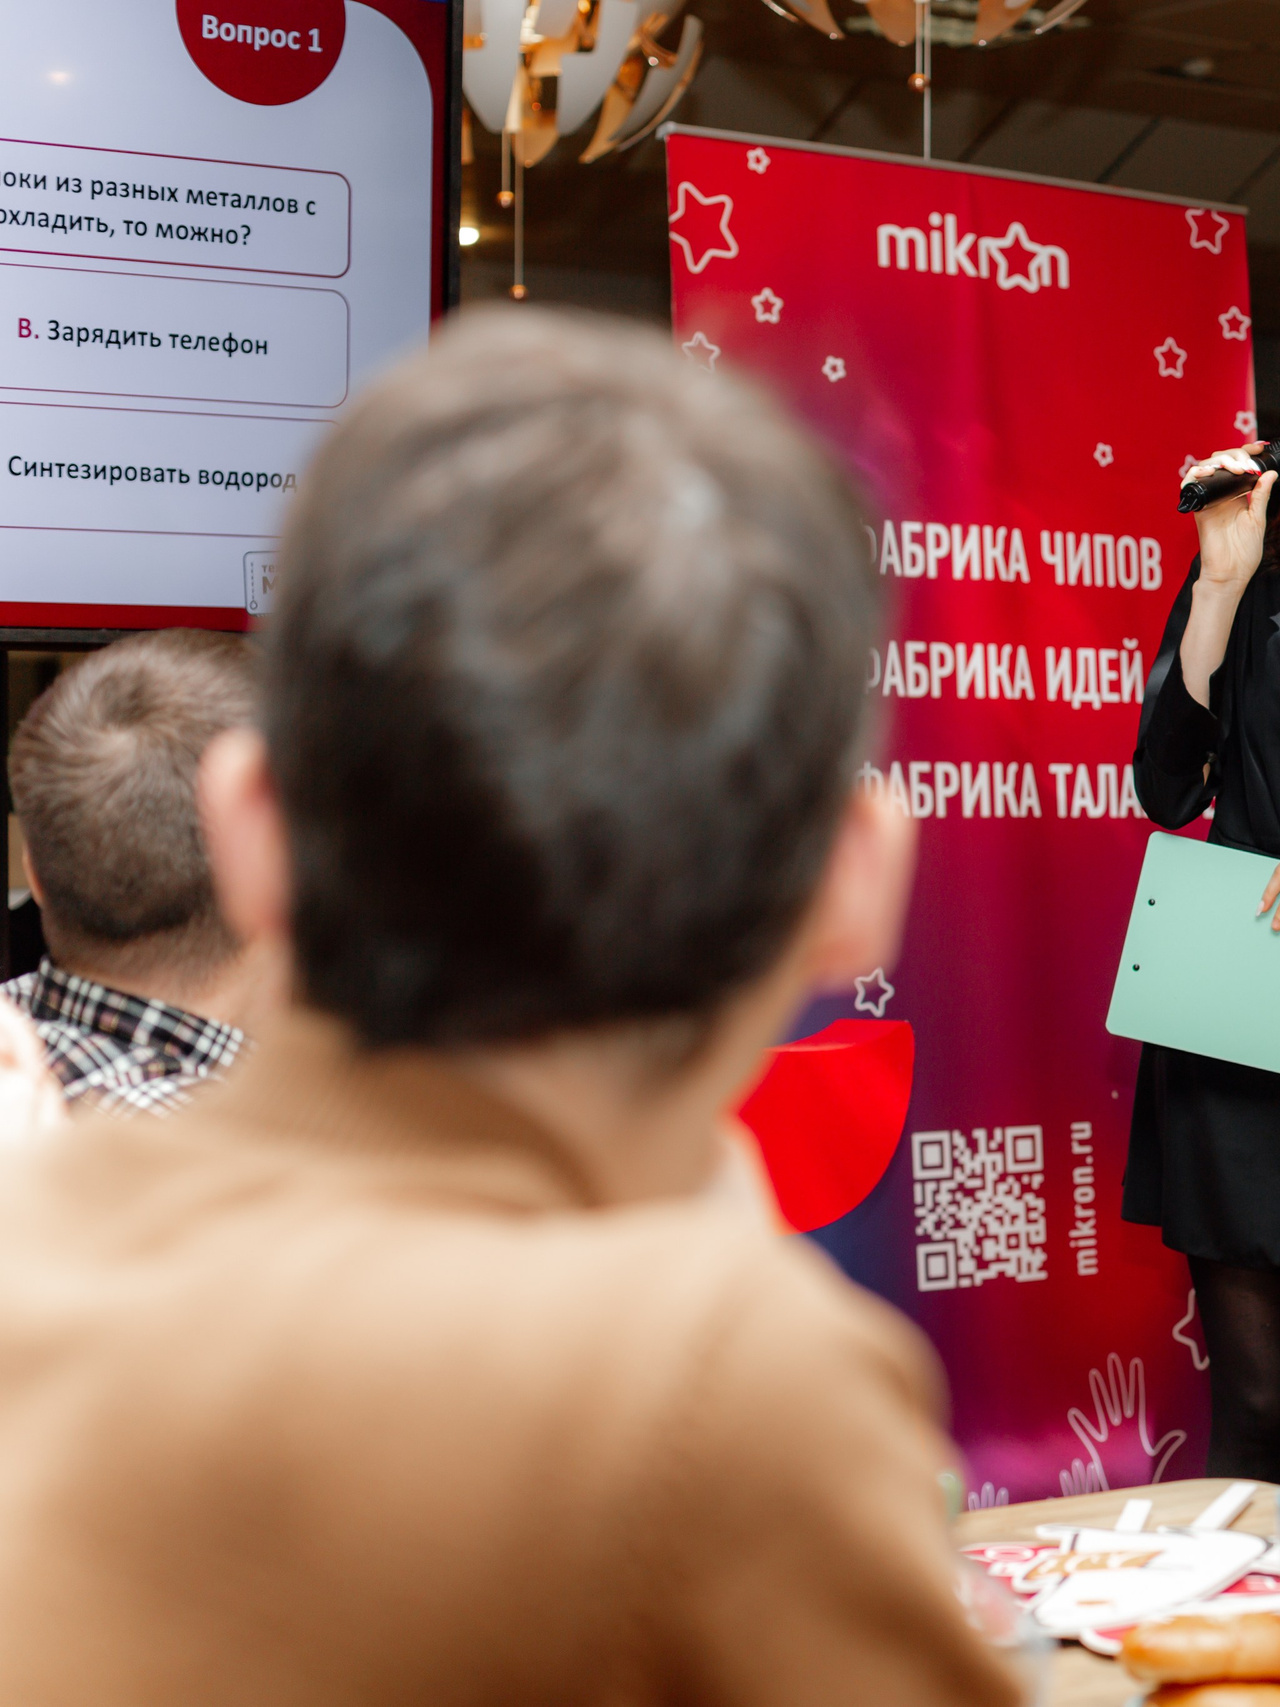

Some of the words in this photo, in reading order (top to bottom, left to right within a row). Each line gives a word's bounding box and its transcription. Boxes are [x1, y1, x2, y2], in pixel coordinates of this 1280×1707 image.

[201, 14, 302, 51] Вопрос
[307, 28, 323, 53] 1
[0, 170, 47, 191] оки
[56, 176, 82, 193] из
[91, 179, 178, 203] разных
[186, 189, 299, 214] металлов
[306, 200, 316, 215] с
[0, 208, 115, 238] охладить,
[123, 219, 148, 239] то
[156, 223, 251, 245] можно?
[47, 320, 162, 349] Зарядить
[169, 332, 268, 357] телефон
[8, 455, 190, 485] Синтезировать
[198, 469, 297, 492] водород
[864, 518, 1031, 584] АБРИКА
[1040, 529, 1163, 591] ЧИПОВ
[1045, 637, 1145, 710] ИДЕЙ
[1069, 1121, 1098, 1277] mikron.ru
